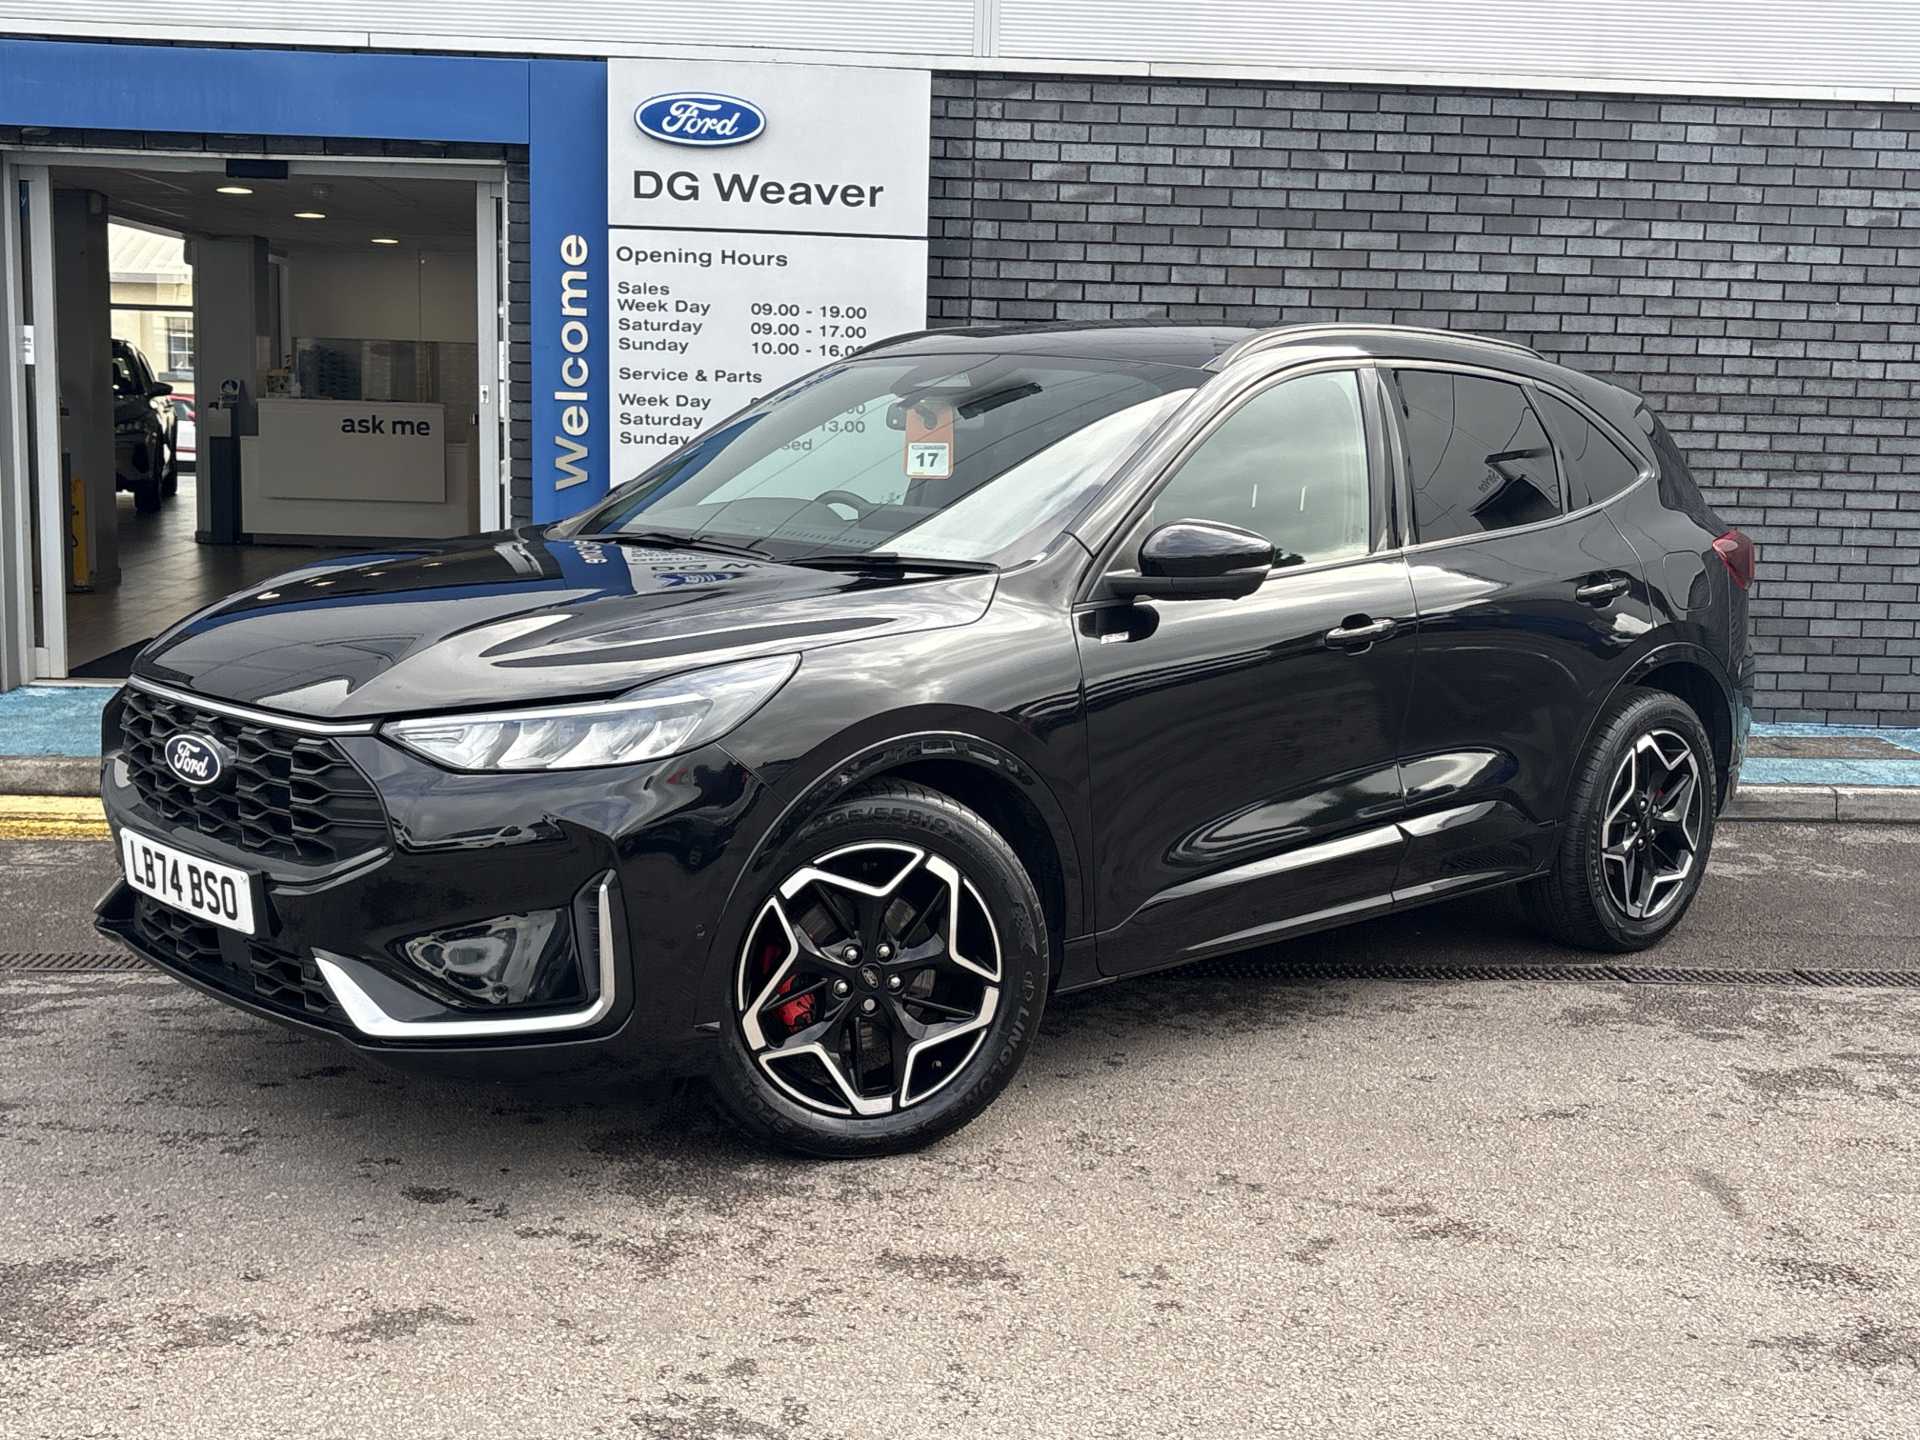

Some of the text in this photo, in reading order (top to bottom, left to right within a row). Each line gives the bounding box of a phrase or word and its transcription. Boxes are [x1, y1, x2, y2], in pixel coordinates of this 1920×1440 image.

[661, 100, 741, 137] Ford
[633, 170, 885, 208] DG Weaver
[616, 246, 788, 268] Opening Hours
[617, 281, 670, 296] Sales
[617, 298, 669, 312] Week
[675, 300, 711, 316] Day
[751, 303, 800, 317] 09.00
[820, 306, 867, 319] 19.00
[618, 317, 703, 335] Saturday
[751, 322, 800, 336] 09.00
[820, 325, 867, 338] 17.00
[618, 337, 689, 354] Sunday
[752, 342, 799, 355] 10.00
[554, 234, 589, 491] Welcome
[619, 367, 762, 383] Service & Parts
[618, 393, 712, 410] Week Day
[341, 415, 431, 436] ask me
[619, 412, 703, 429] Saturday
[916, 452, 939, 467] 17
[130, 840, 238, 920] LB74 BSO
